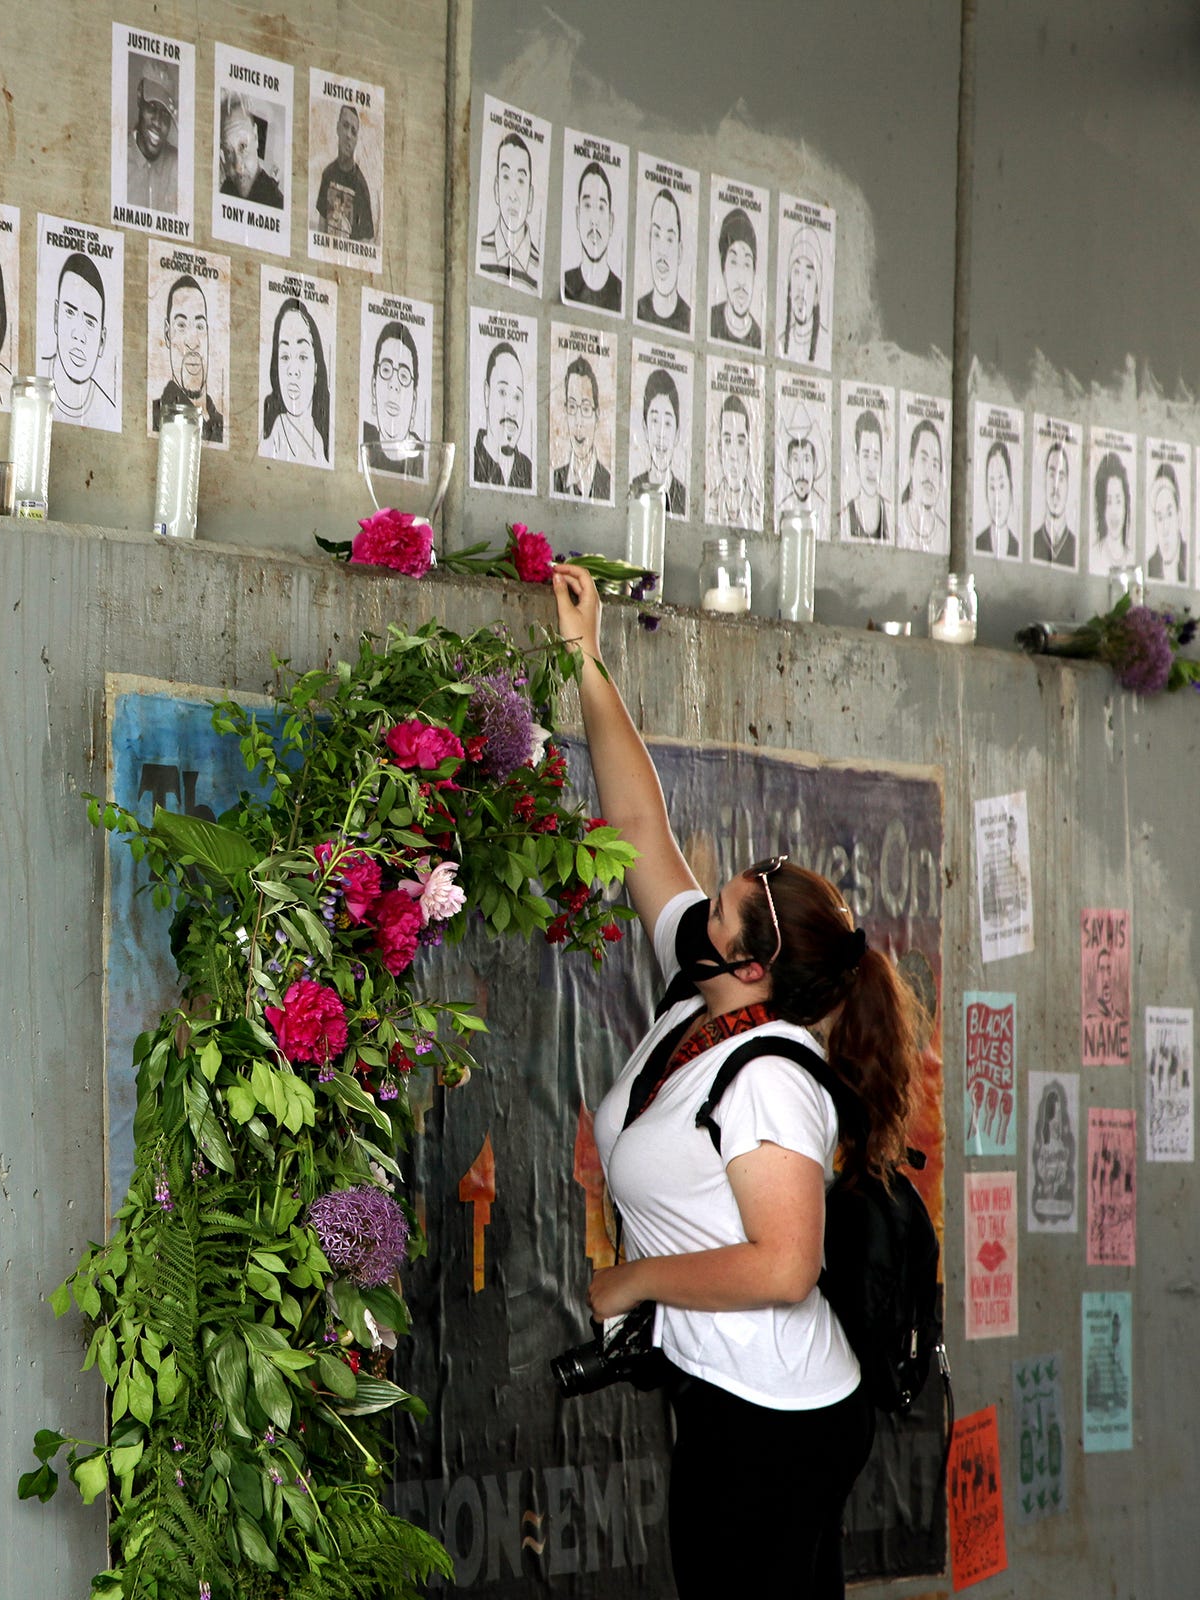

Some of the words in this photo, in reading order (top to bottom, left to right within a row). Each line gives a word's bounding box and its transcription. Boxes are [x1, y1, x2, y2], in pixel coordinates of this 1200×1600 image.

[127, 31, 161, 55] JUSTICE
[163, 41, 181, 61] FOR
[228, 63, 261, 87] JUSTICE
[263, 72, 280, 92] FOR
[322, 80, 353, 101] JUSTICE
[355, 90, 372, 108] FOR
[113, 205, 152, 228] AHMAUD
[156, 215, 190, 237] ARBERY
[221, 204, 244, 224] TONY
[247, 212, 281, 233] McDADE
[46, 231, 86, 253] FREDDIE
[87, 240, 114, 260] GRAY
[62, 225, 86, 240] JUSTICE
[86, 230, 99, 241] FOR
[172, 250, 195, 264] JUSTICE
[195, 255, 207, 266] FOR
[312, 234, 331, 248] SEAN
[333, 238, 377, 260] MONTERROSA
[160, 256, 192, 274] GEORGE
[194, 262, 219, 281] FLOYD
[283, 275, 303, 288] JUSTIC
[304, 280, 315, 291] FOR
[302, 287, 330, 305] TAYLOR
[382, 297, 402, 310] JUSTICE
[402, 301, 413, 312] FOR
[367, 303, 399, 319] DEBORAH
[400, 310, 426, 327] DANNER
[488, 315, 507, 328] JUSTICE
[508, 318, 519, 329] FOR
[478, 323, 506, 340] WALTER
[507, 328, 528, 343] SCOTT
[570, 330, 588, 341] JUSTICE
[589, 334, 599, 343] FOR
[1084, 917, 1104, 949] SAY
[1106, 918, 1126, 949] HIS
[970, 1008, 1011, 1038] BLACK
[969, 1037, 1011, 1065] LIVES
[1084, 1021, 1129, 1059] NAME
[968, 1058, 1011, 1084] MATTER
[970, 1189, 990, 1213] KNOW
[992, 1187, 1012, 1212] WHEN
[977, 1216, 987, 1239] TO
[988, 1215, 1007, 1238] TALK
[971, 1275, 992, 1299] KNOW
[974, 1301, 984, 1325] TO
[985, 1300, 1010, 1325] LISTEN
